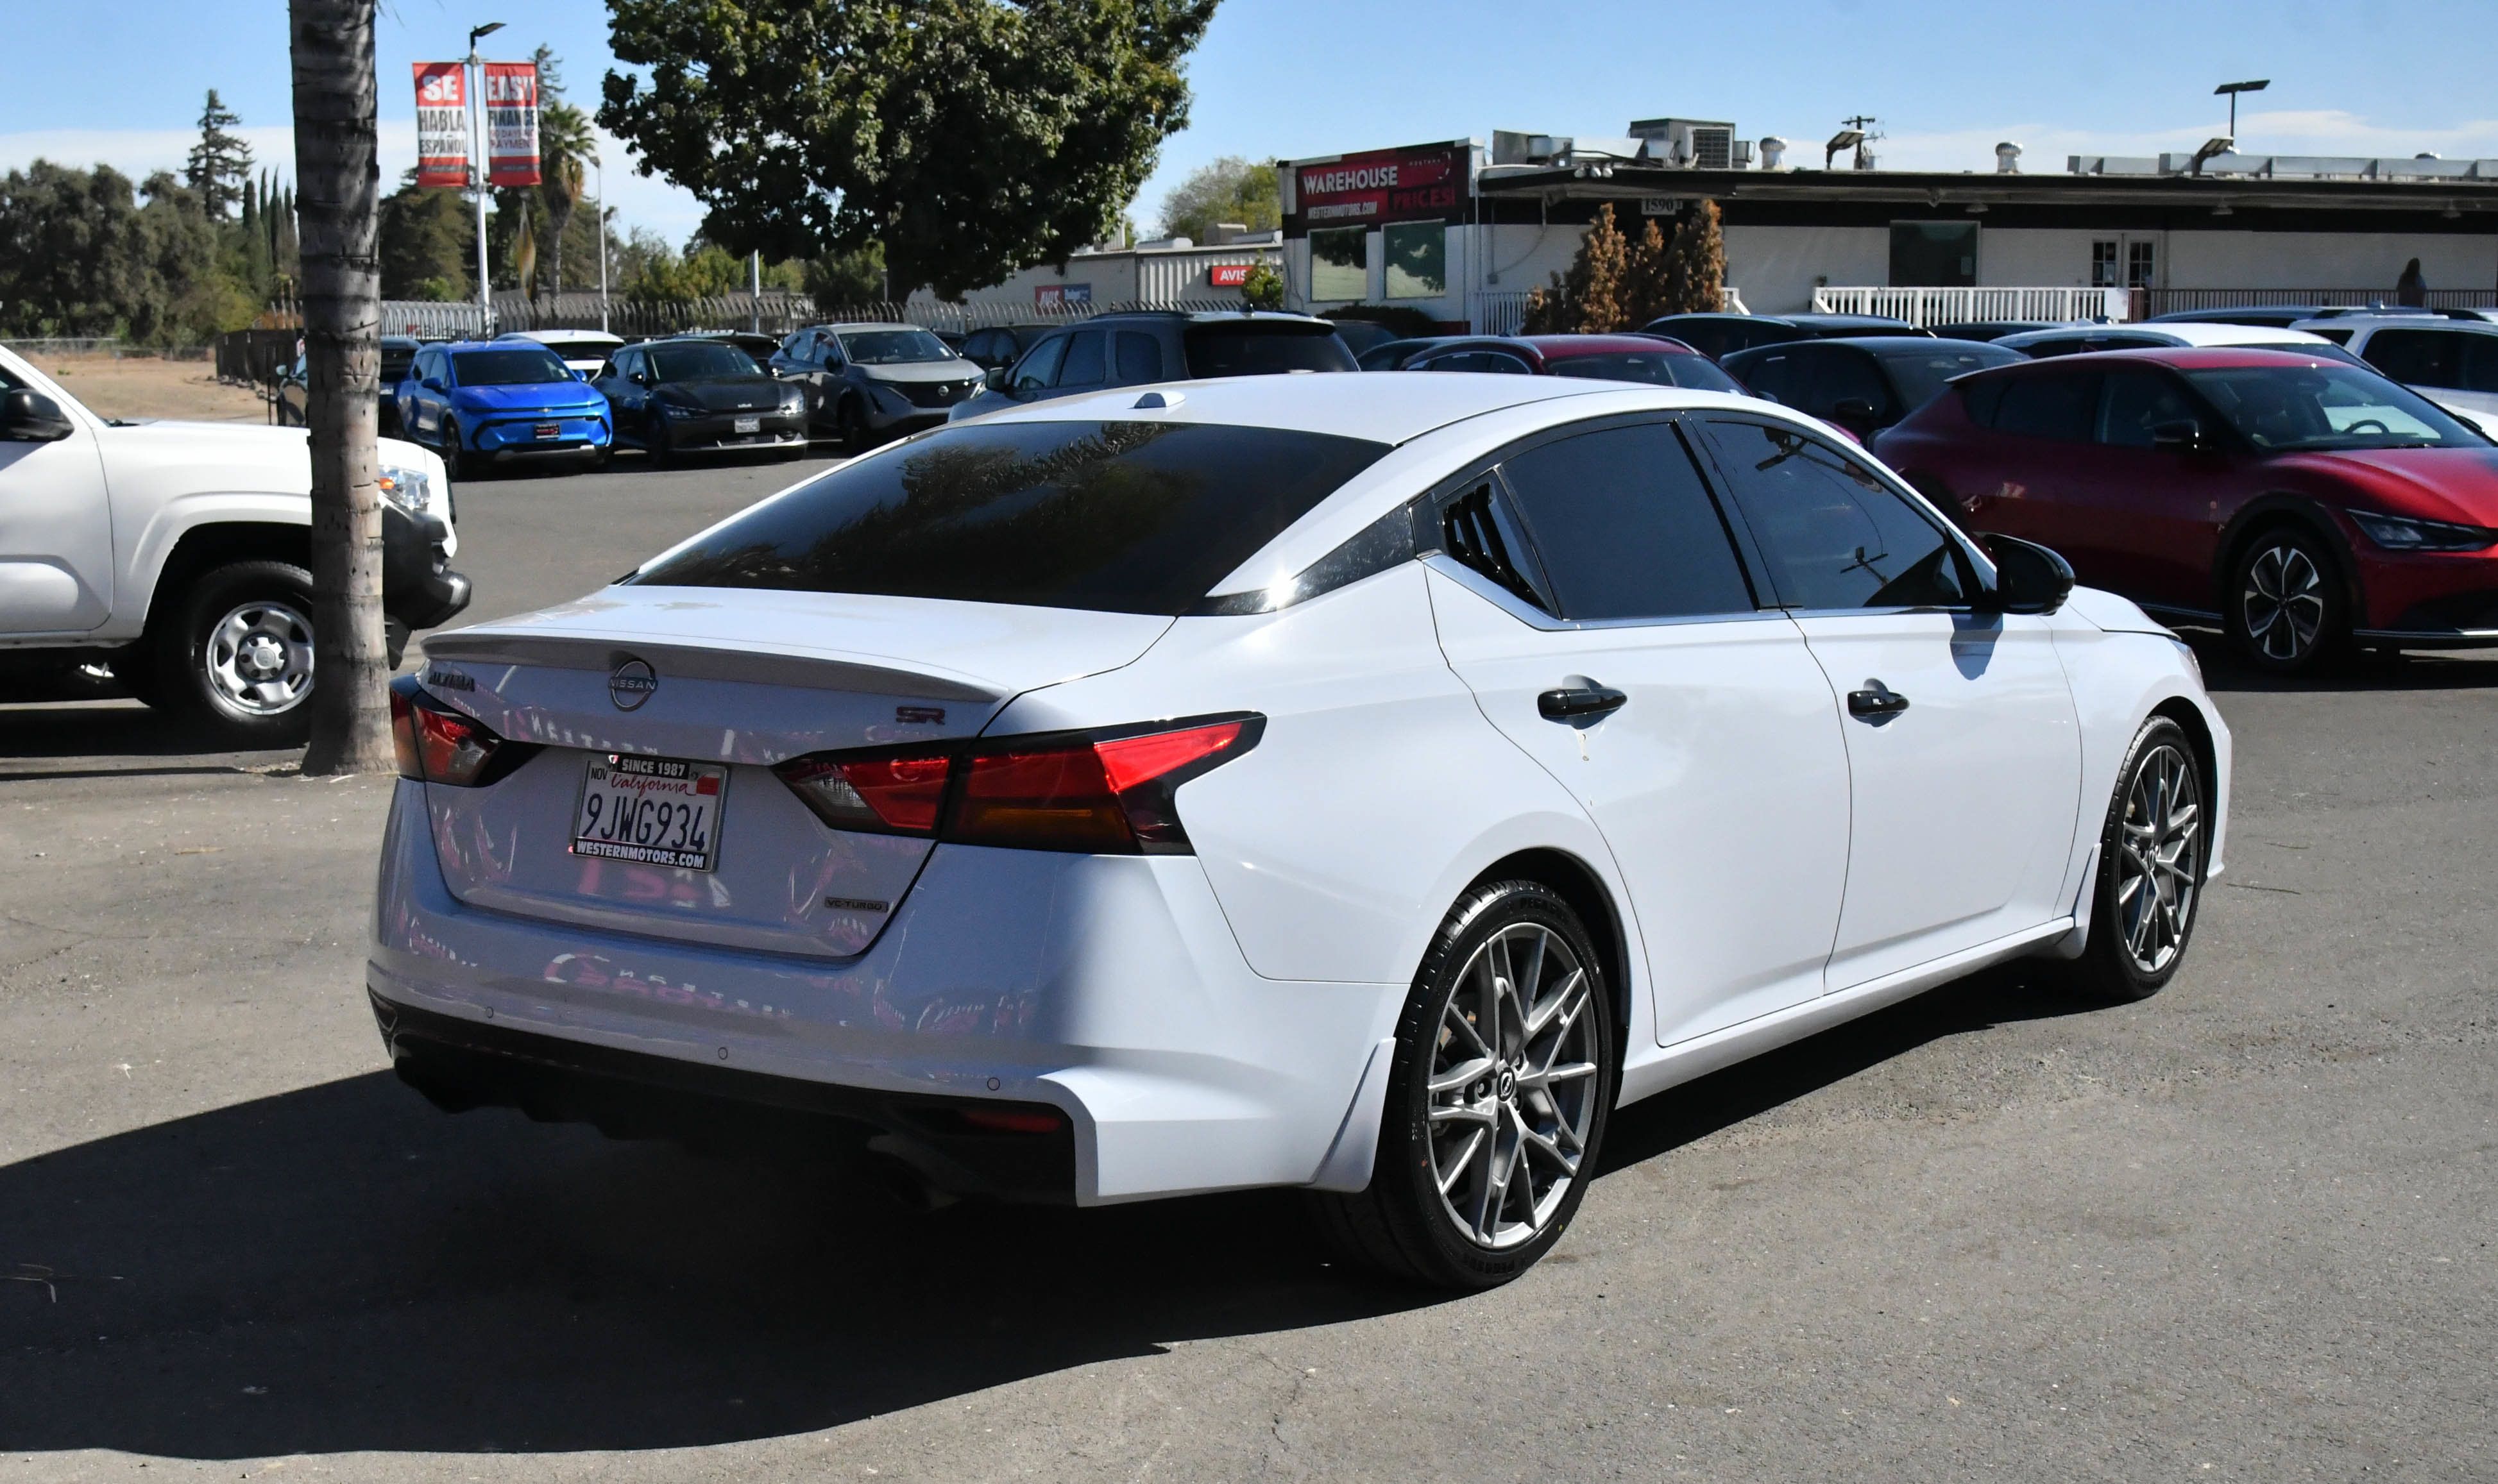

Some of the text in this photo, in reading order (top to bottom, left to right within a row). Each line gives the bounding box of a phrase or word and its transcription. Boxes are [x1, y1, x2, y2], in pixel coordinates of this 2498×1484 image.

[423, 75, 458, 101] SE
[487, 75, 535, 101] EASY
[419, 110, 466, 132] HABLA
[489, 109, 535, 127] FINANCE
[419, 134, 468, 153] ESPAÑOL
[1303, 165, 1398, 195] WAREHOUSE
[1219, 269, 1247, 282] AVIS
[609, 678, 656, 691] NISSAN
[896, 706, 946, 725] SR
[591, 766, 608, 780] NOV
[622, 758, 686, 777] SINCE 1987
[611, 772, 697, 797] California
[582, 792, 706, 852] 9JWG934
[576, 841, 705, 868] WESTERNMOTORS.COM
[827, 899, 883, 910] VC-TURBO
